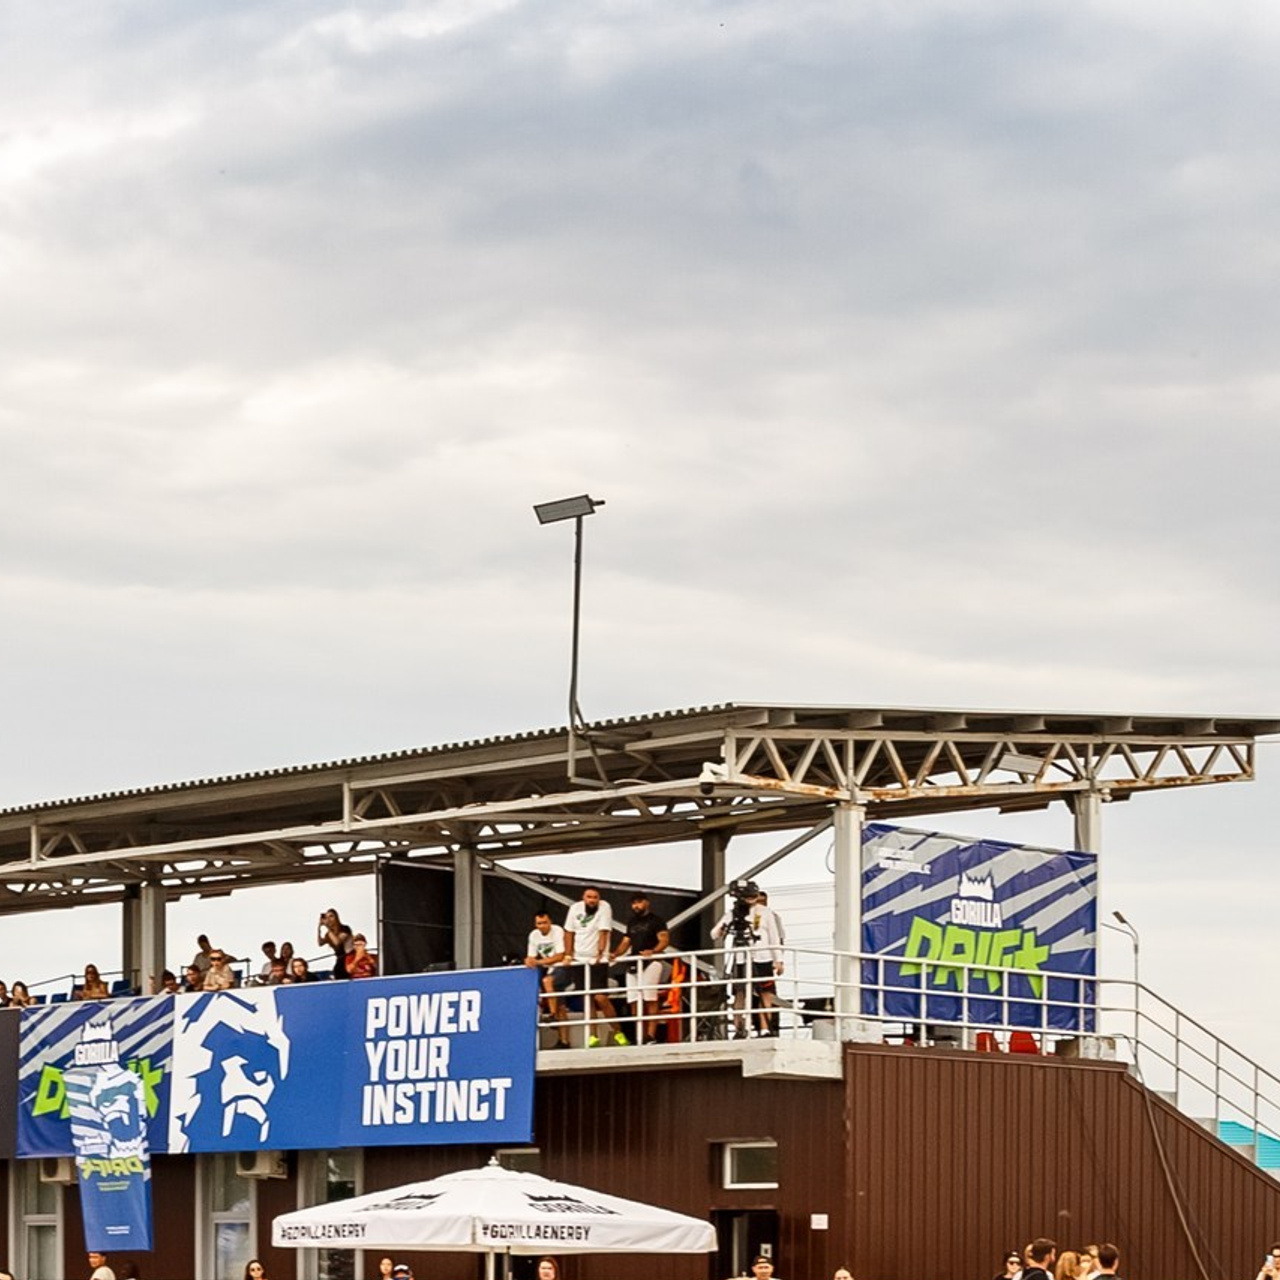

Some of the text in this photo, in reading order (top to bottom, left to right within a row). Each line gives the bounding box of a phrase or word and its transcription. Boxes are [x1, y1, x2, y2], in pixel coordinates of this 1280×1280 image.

[951, 899, 1002, 928] GORILLA
[899, 916, 1050, 998] DRIFT
[366, 990, 481, 1038] POWER
[75, 1041, 119, 1066] GORILLA
[365, 1037, 450, 1081] YOUR
[362, 1078, 512, 1127] INSTINCT
[482, 1224, 591, 1241] #GORILLAENERGY
